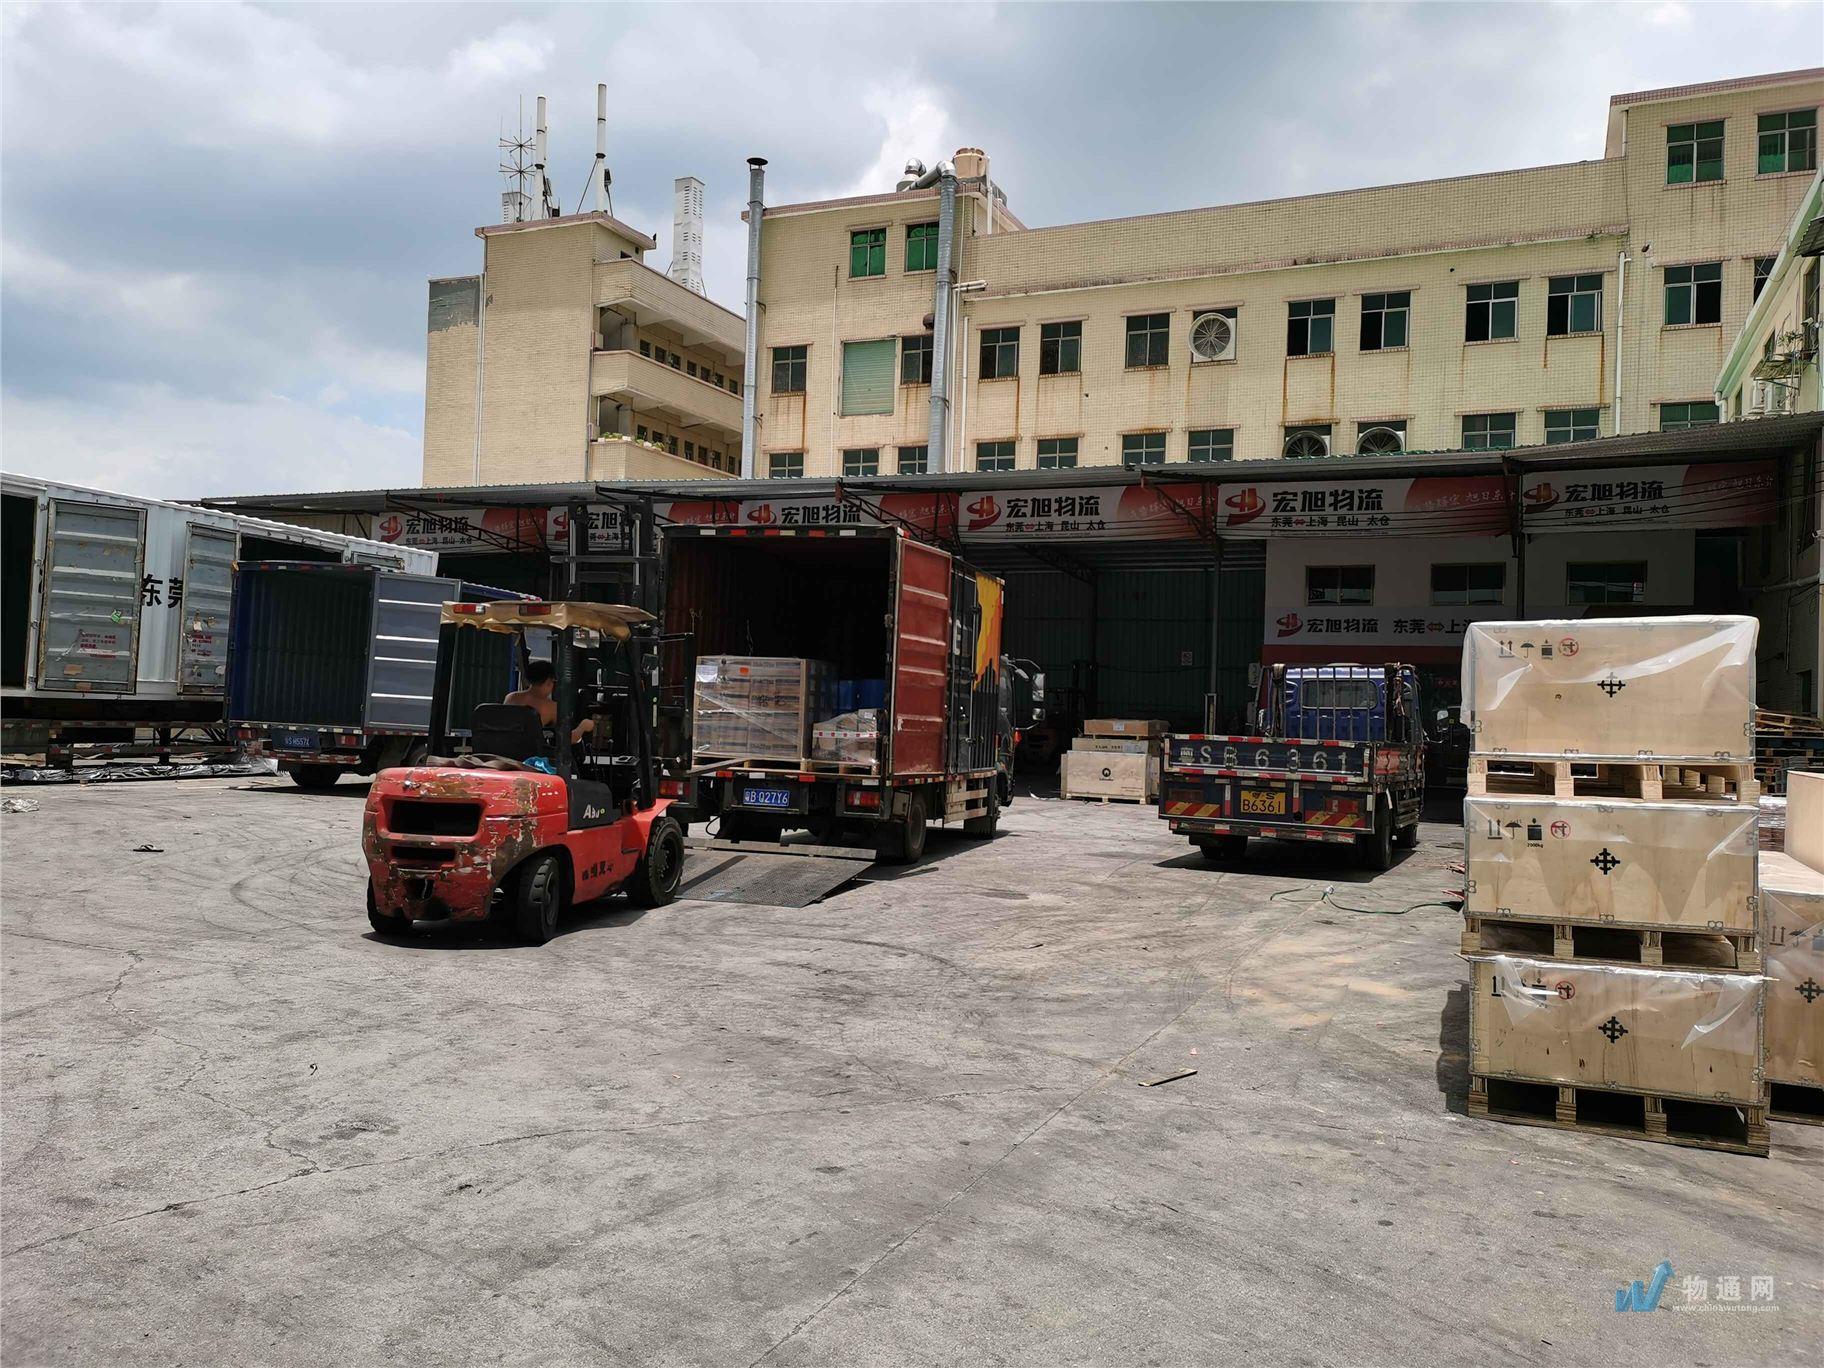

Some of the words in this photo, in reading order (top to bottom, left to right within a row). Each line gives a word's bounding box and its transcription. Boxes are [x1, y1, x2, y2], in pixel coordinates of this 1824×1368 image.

[1272, 488, 1384, 512] 宏旭物流
[1565, 481, 1664, 502] 宏旭物流
[781, 503, 862, 524] 宏旭物流
[1007, 495, 1101, 518] 宏旭物流
[1624, 505, 1642, 514] 昆山
[1650, 504, 1670, 514] 太仓
[407, 516, 469, 534] 宏旭物流
[1005, 521, 1025, 532] 东莞
[1034, 520, 1054, 532] 上海
[1061, 519, 1080, 531] 昆山
[1086, 519, 1106, 531] 太仓
[1271, 515, 1293, 528] 东莞
[1306, 515, 1328, 527] 上海
[1336, 515, 1359, 527] 昆山
[1367, 514, 1390, 526] 太仓
[1307, 618, 1379, 634] 宏旭物流
[1393, 618, 1426, 634] 东莞
[1242, 799, 1281, 812] B6361
